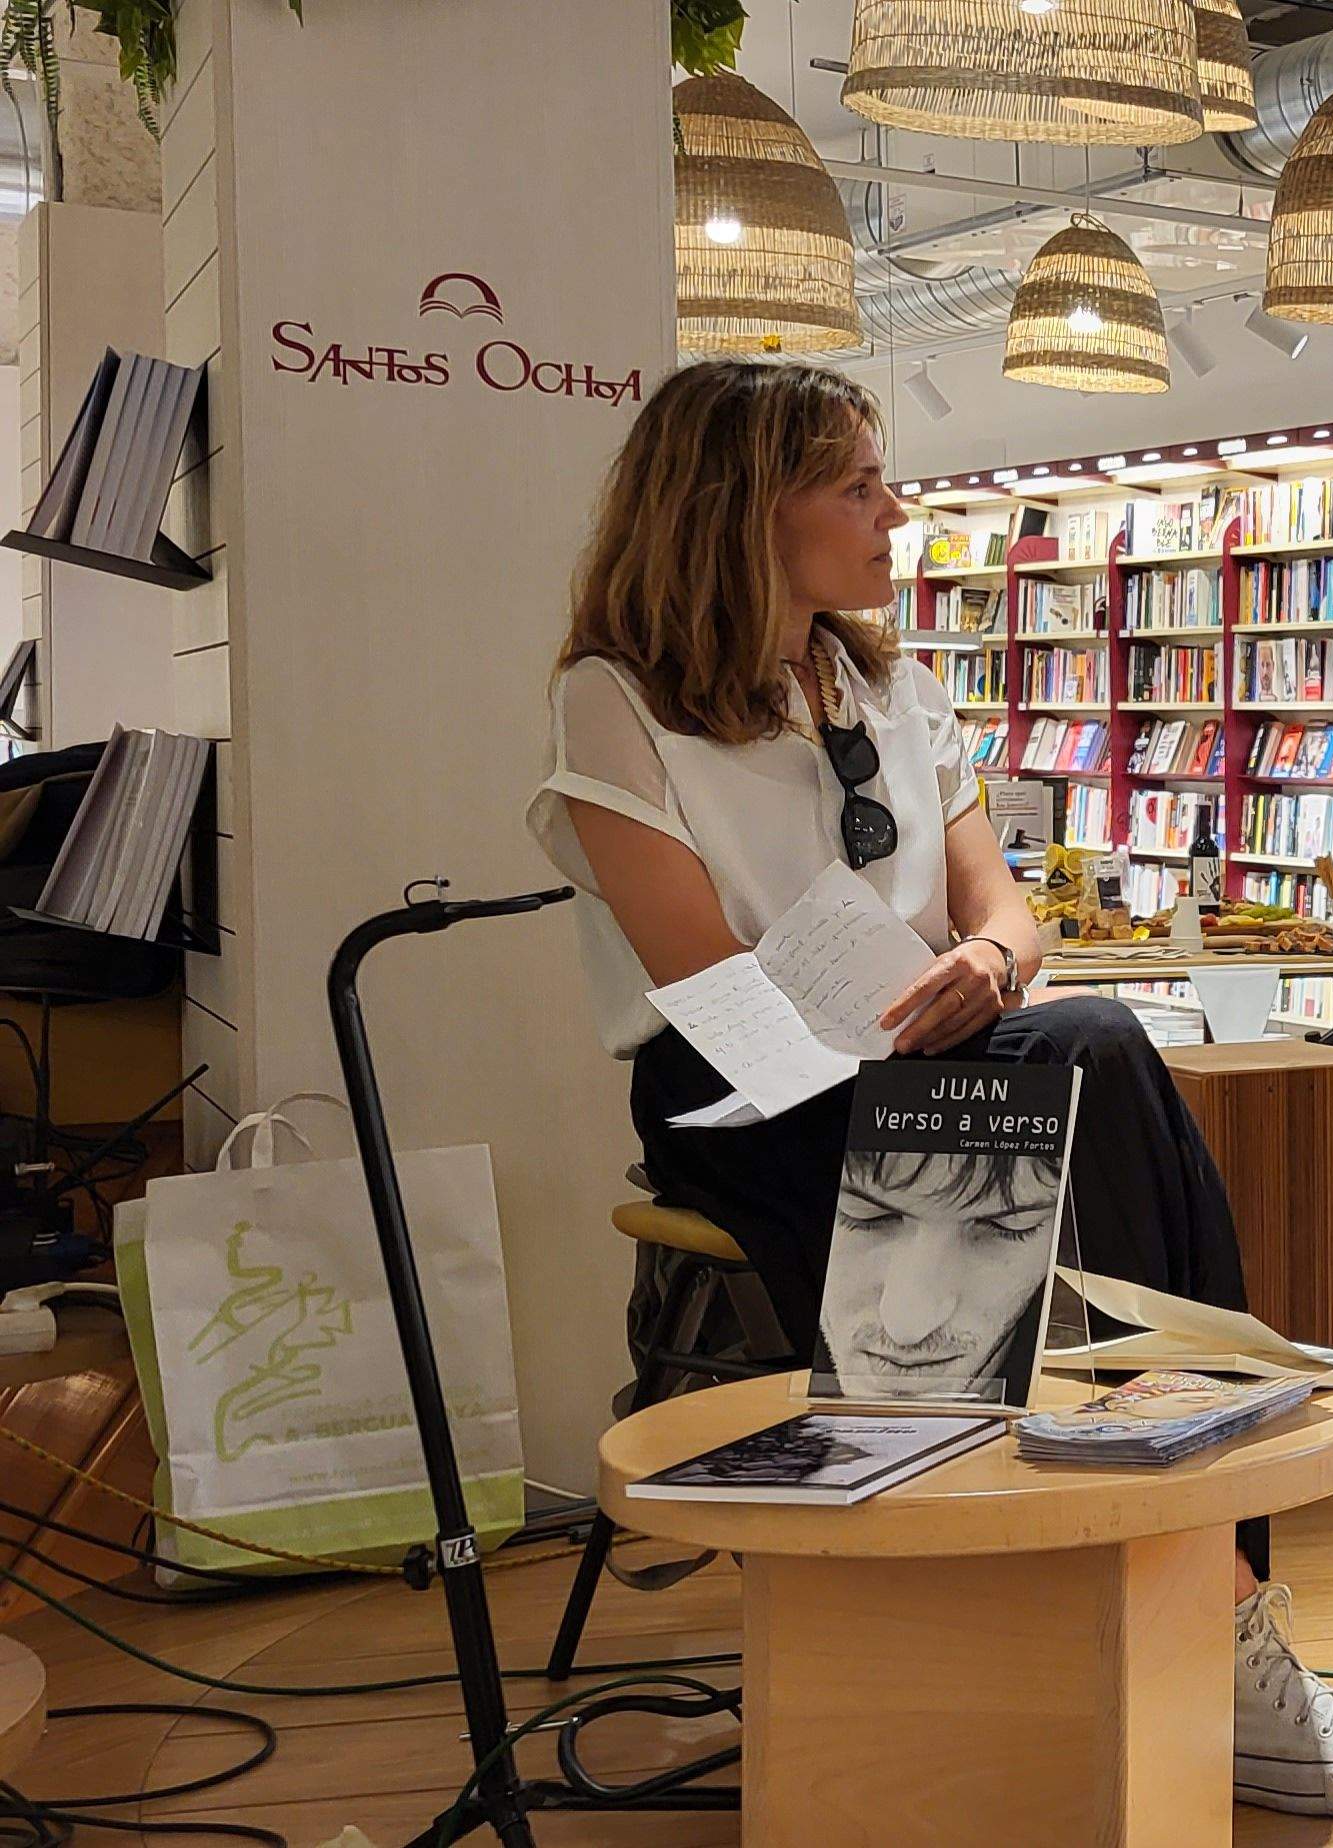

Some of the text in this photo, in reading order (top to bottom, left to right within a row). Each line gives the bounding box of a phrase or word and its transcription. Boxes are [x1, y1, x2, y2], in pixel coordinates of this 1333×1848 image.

[271, 320, 642, 407] SANTOS OCHOA
[931, 1077, 1009, 1102] JUAN
[875, 1106, 1059, 1135] Verso a verso
[959, 1139, 990, 1149] Carmen
